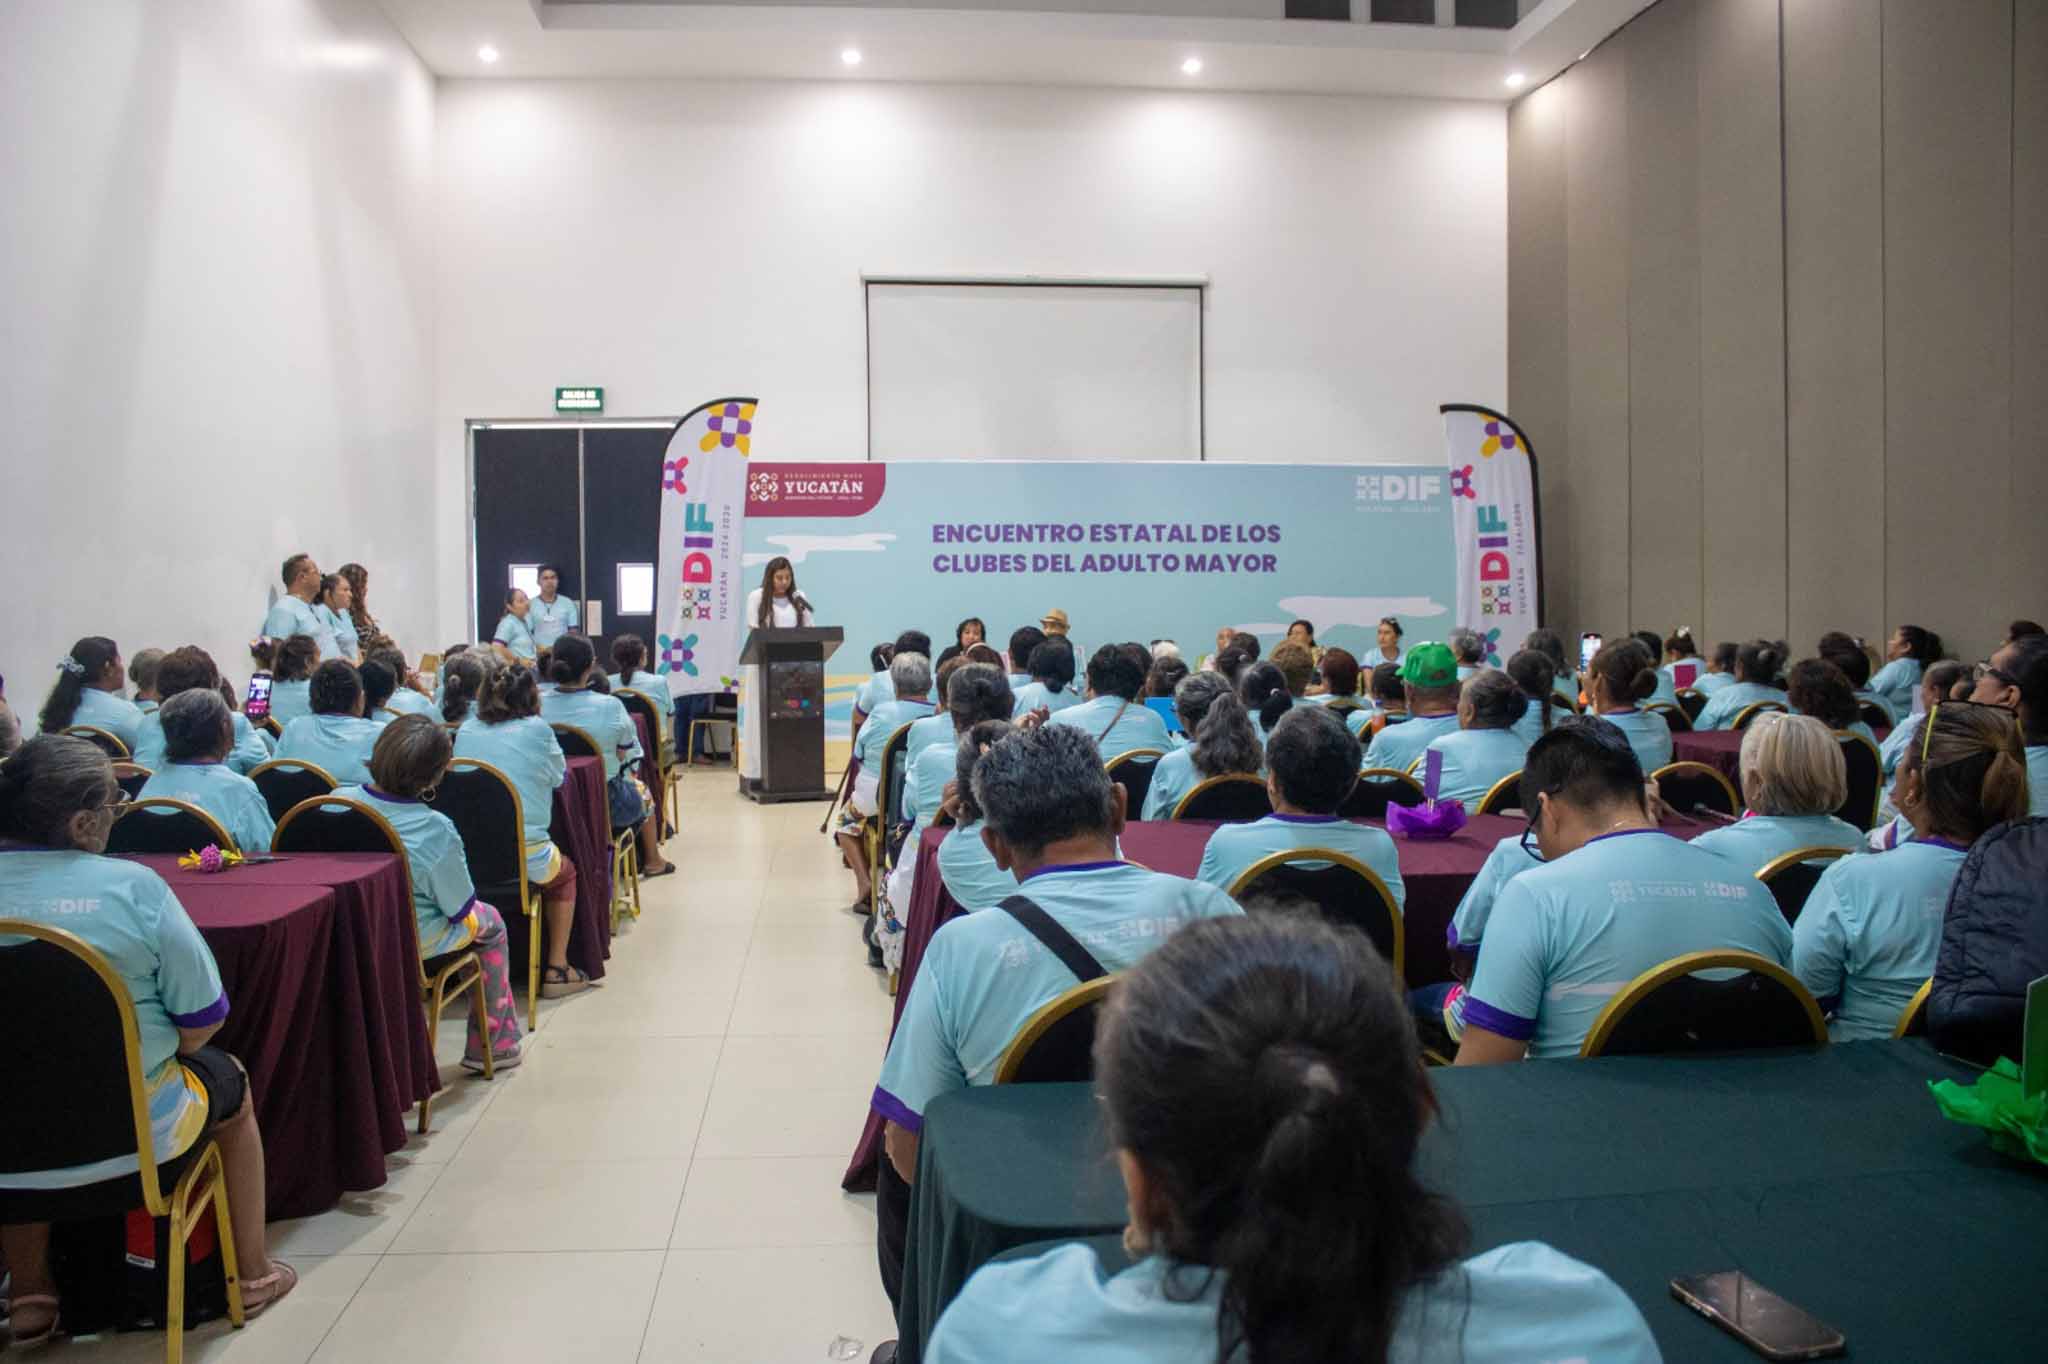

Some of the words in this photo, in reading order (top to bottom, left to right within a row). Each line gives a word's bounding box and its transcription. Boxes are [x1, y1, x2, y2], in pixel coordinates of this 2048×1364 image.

[784, 480, 864, 494] YUCATÁN
[1382, 475, 1441, 501] DIF
[682, 503, 714, 584] DIF
[932, 524, 1085, 543] ENCUENTRO
[1090, 524, 1197, 543] ESTATAL
[1202, 524, 1232, 543] DE
[1237, 524, 1281, 543] LOS
[1477, 504, 1511, 582] DIF
[932, 554, 1027, 573] CLUBES
[1032, 554, 1075, 573] DEL
[1080, 554, 1180, 573] ADULTO
[1185, 554, 1278, 573] MAYOR
